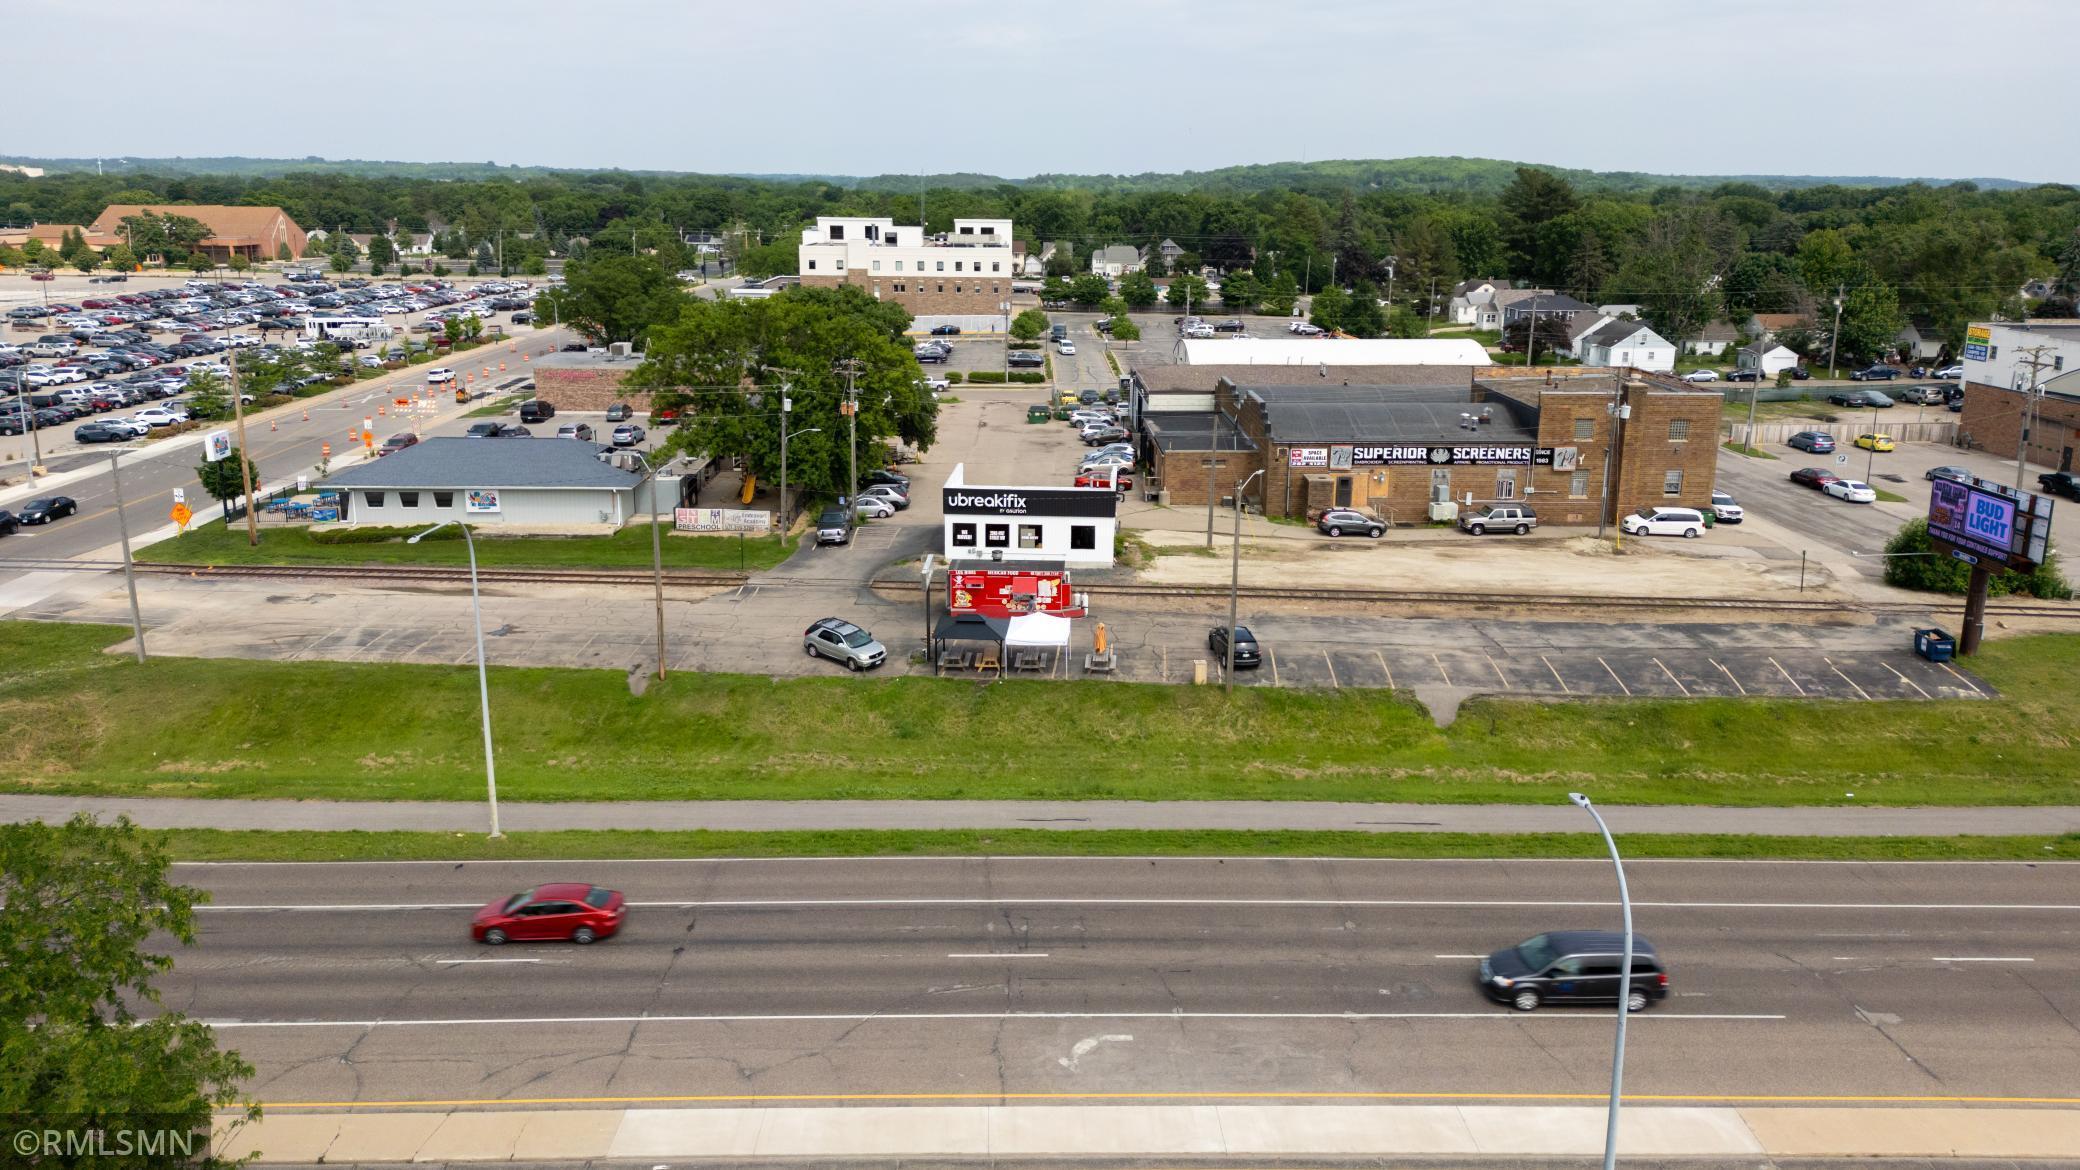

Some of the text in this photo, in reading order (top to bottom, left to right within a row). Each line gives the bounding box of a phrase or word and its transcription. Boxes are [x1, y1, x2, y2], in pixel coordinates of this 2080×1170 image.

[1354, 447, 1427, 459] SUPERIOR
[1453, 447, 1531, 459] SCREENERS
[948, 493, 1027, 508] ubreakifix
[1976, 499, 2004, 520] BUD
[1969, 513, 2008, 538] LIGHT
